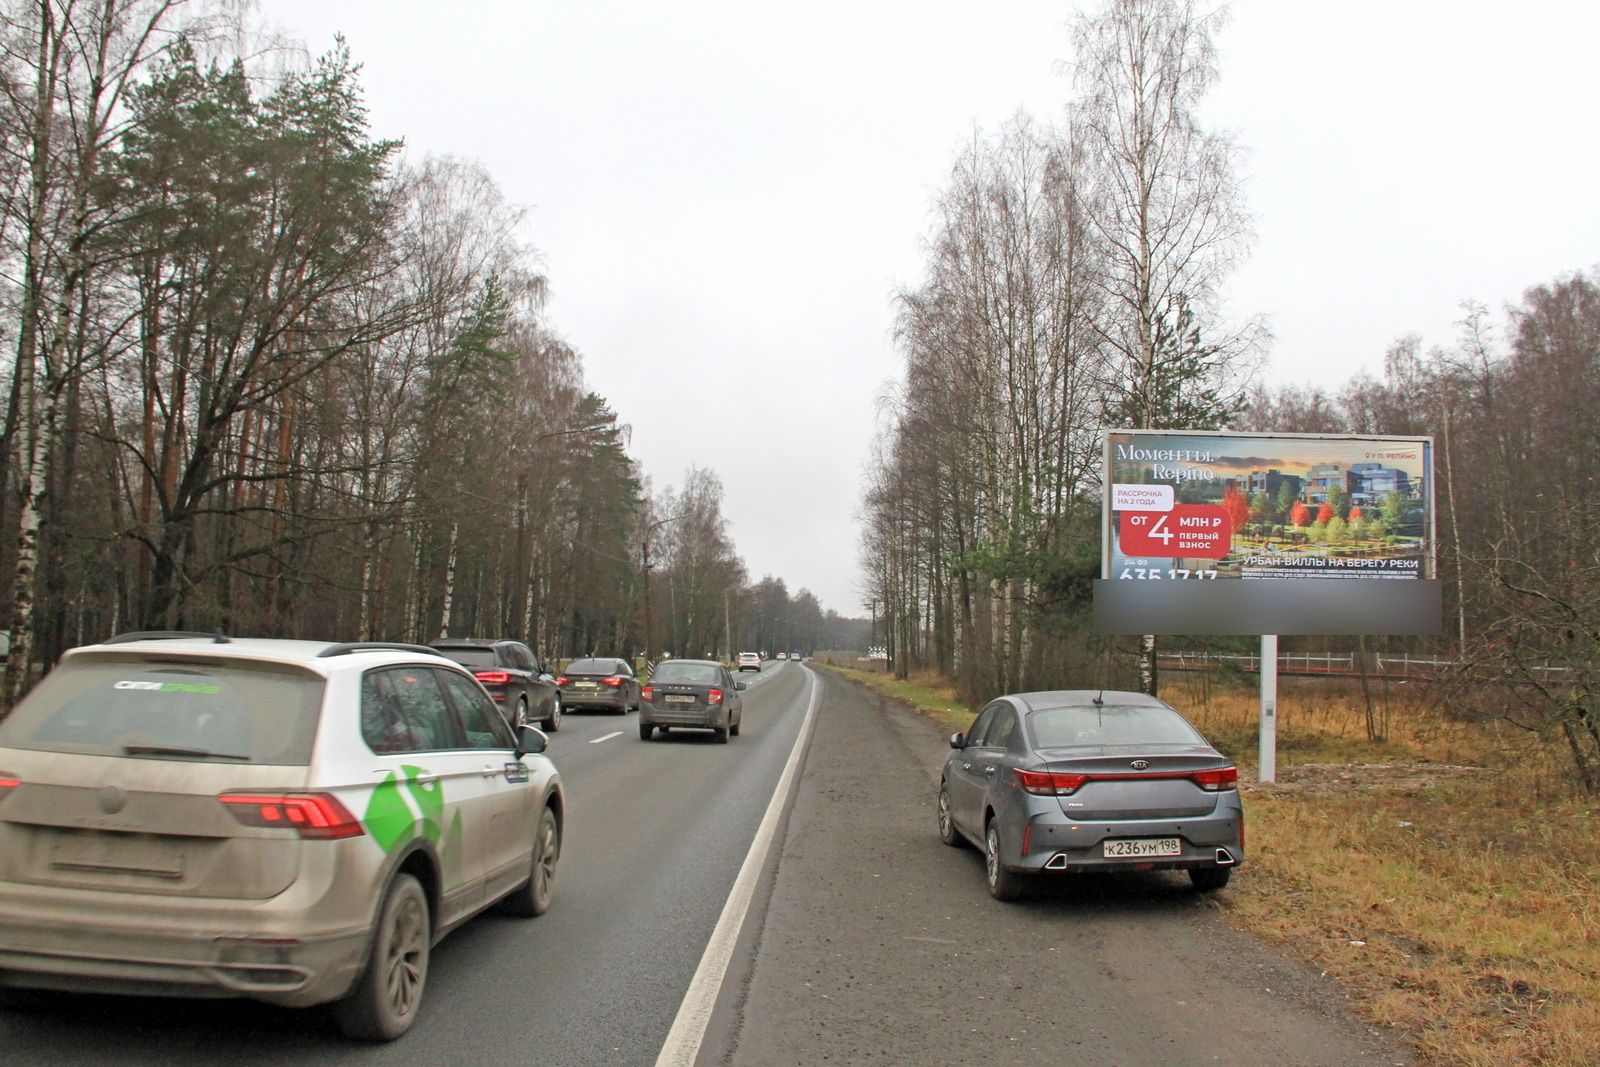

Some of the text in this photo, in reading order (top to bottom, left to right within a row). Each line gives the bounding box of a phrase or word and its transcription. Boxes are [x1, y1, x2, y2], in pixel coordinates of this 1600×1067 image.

[1117, 444, 1214, 462] Моменты.
[1153, 463, 1216, 484] Repino
[1179, 517, 1209, 527] МЛН
[1130, 515, 1175, 546] ОТ 4
[1179, 532, 1219, 540] ПЕРВЫЙ
[1179, 541, 1211, 549] ВЗНОС
[1243, 556, 1418, 568] УРБАН-ВИЛЛЫ НА БЕРЕГУ РЕКИ
